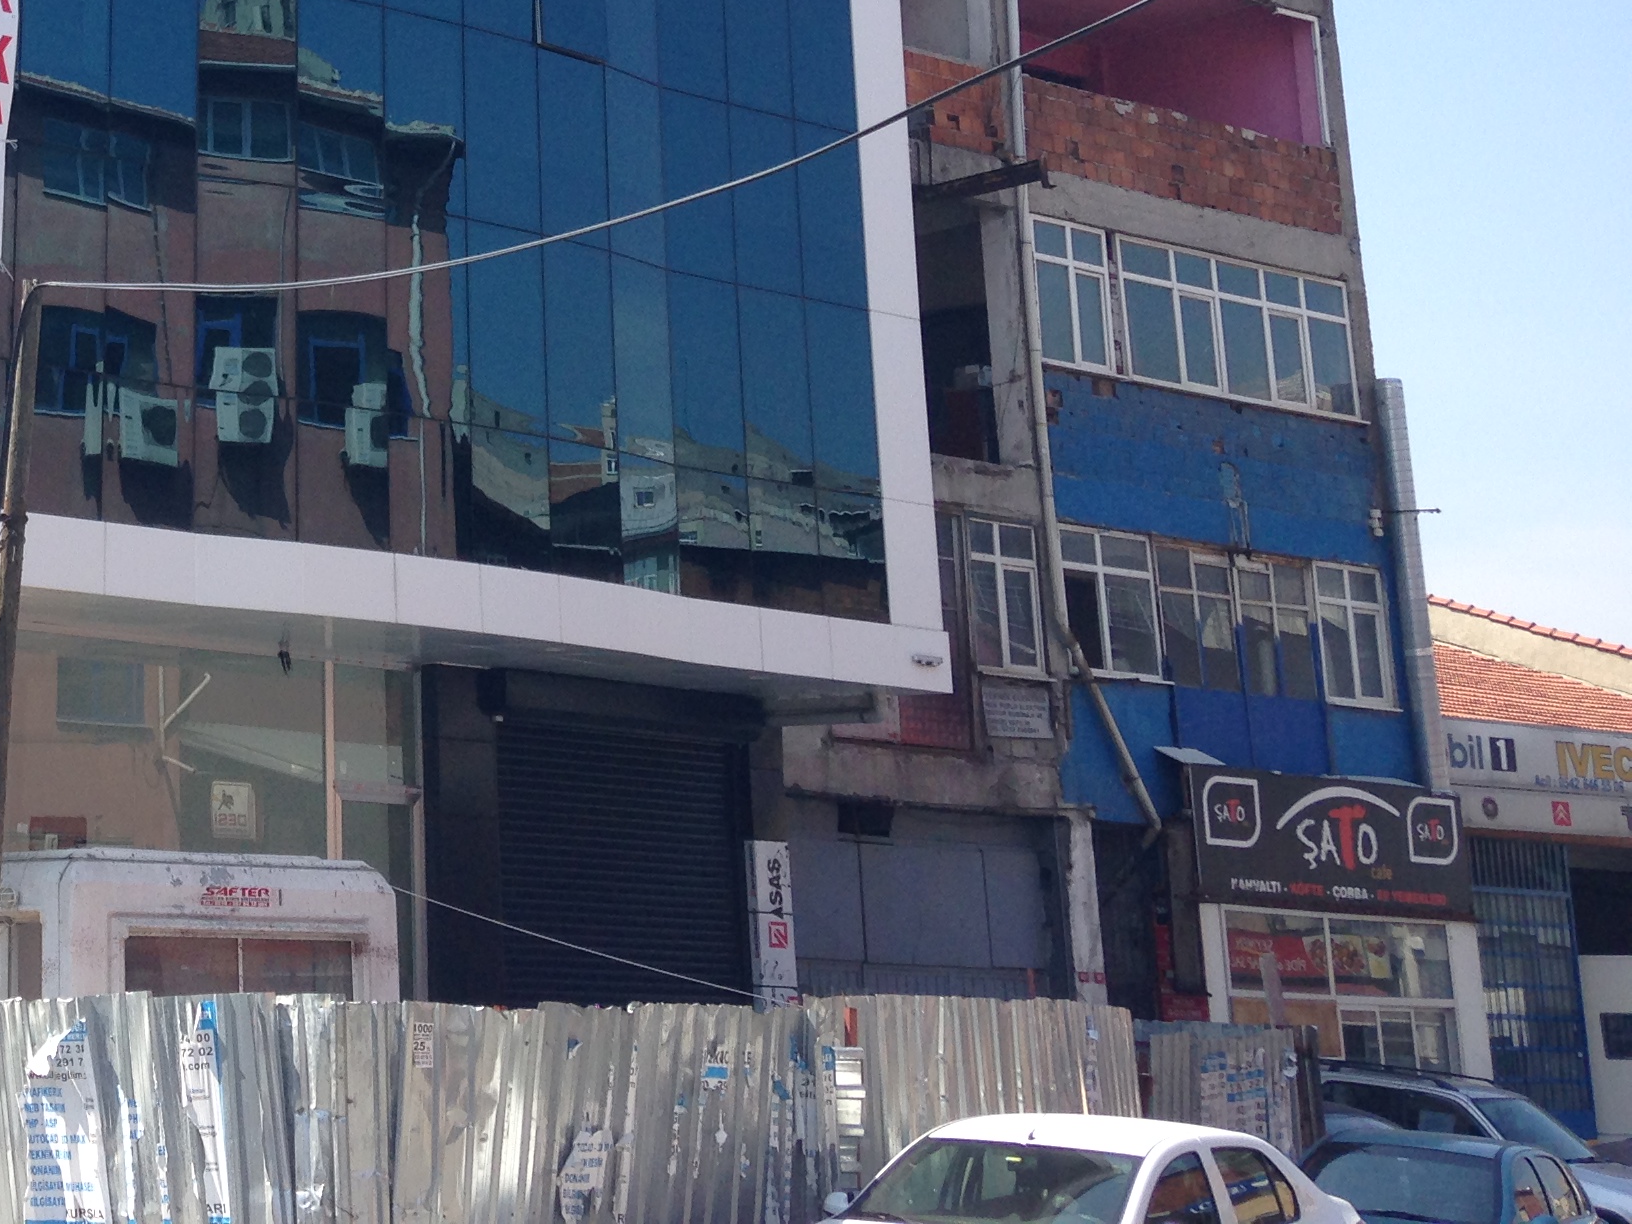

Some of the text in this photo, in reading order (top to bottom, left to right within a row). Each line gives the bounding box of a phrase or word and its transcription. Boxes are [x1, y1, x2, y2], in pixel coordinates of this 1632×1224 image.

[1445, 733, 1508, 771] bil 1
[1296, 803, 1378, 870] ŞATO
[202, 887, 270, 897] SAFTER
[1332, 885, 1368, 902] ÇORBA
[413, 1024, 432, 1033] 1000
[196, 1033, 210, 1043] 00
[199, 1046, 214, 1056] 02
[413, 1041, 426, 1051] 25
